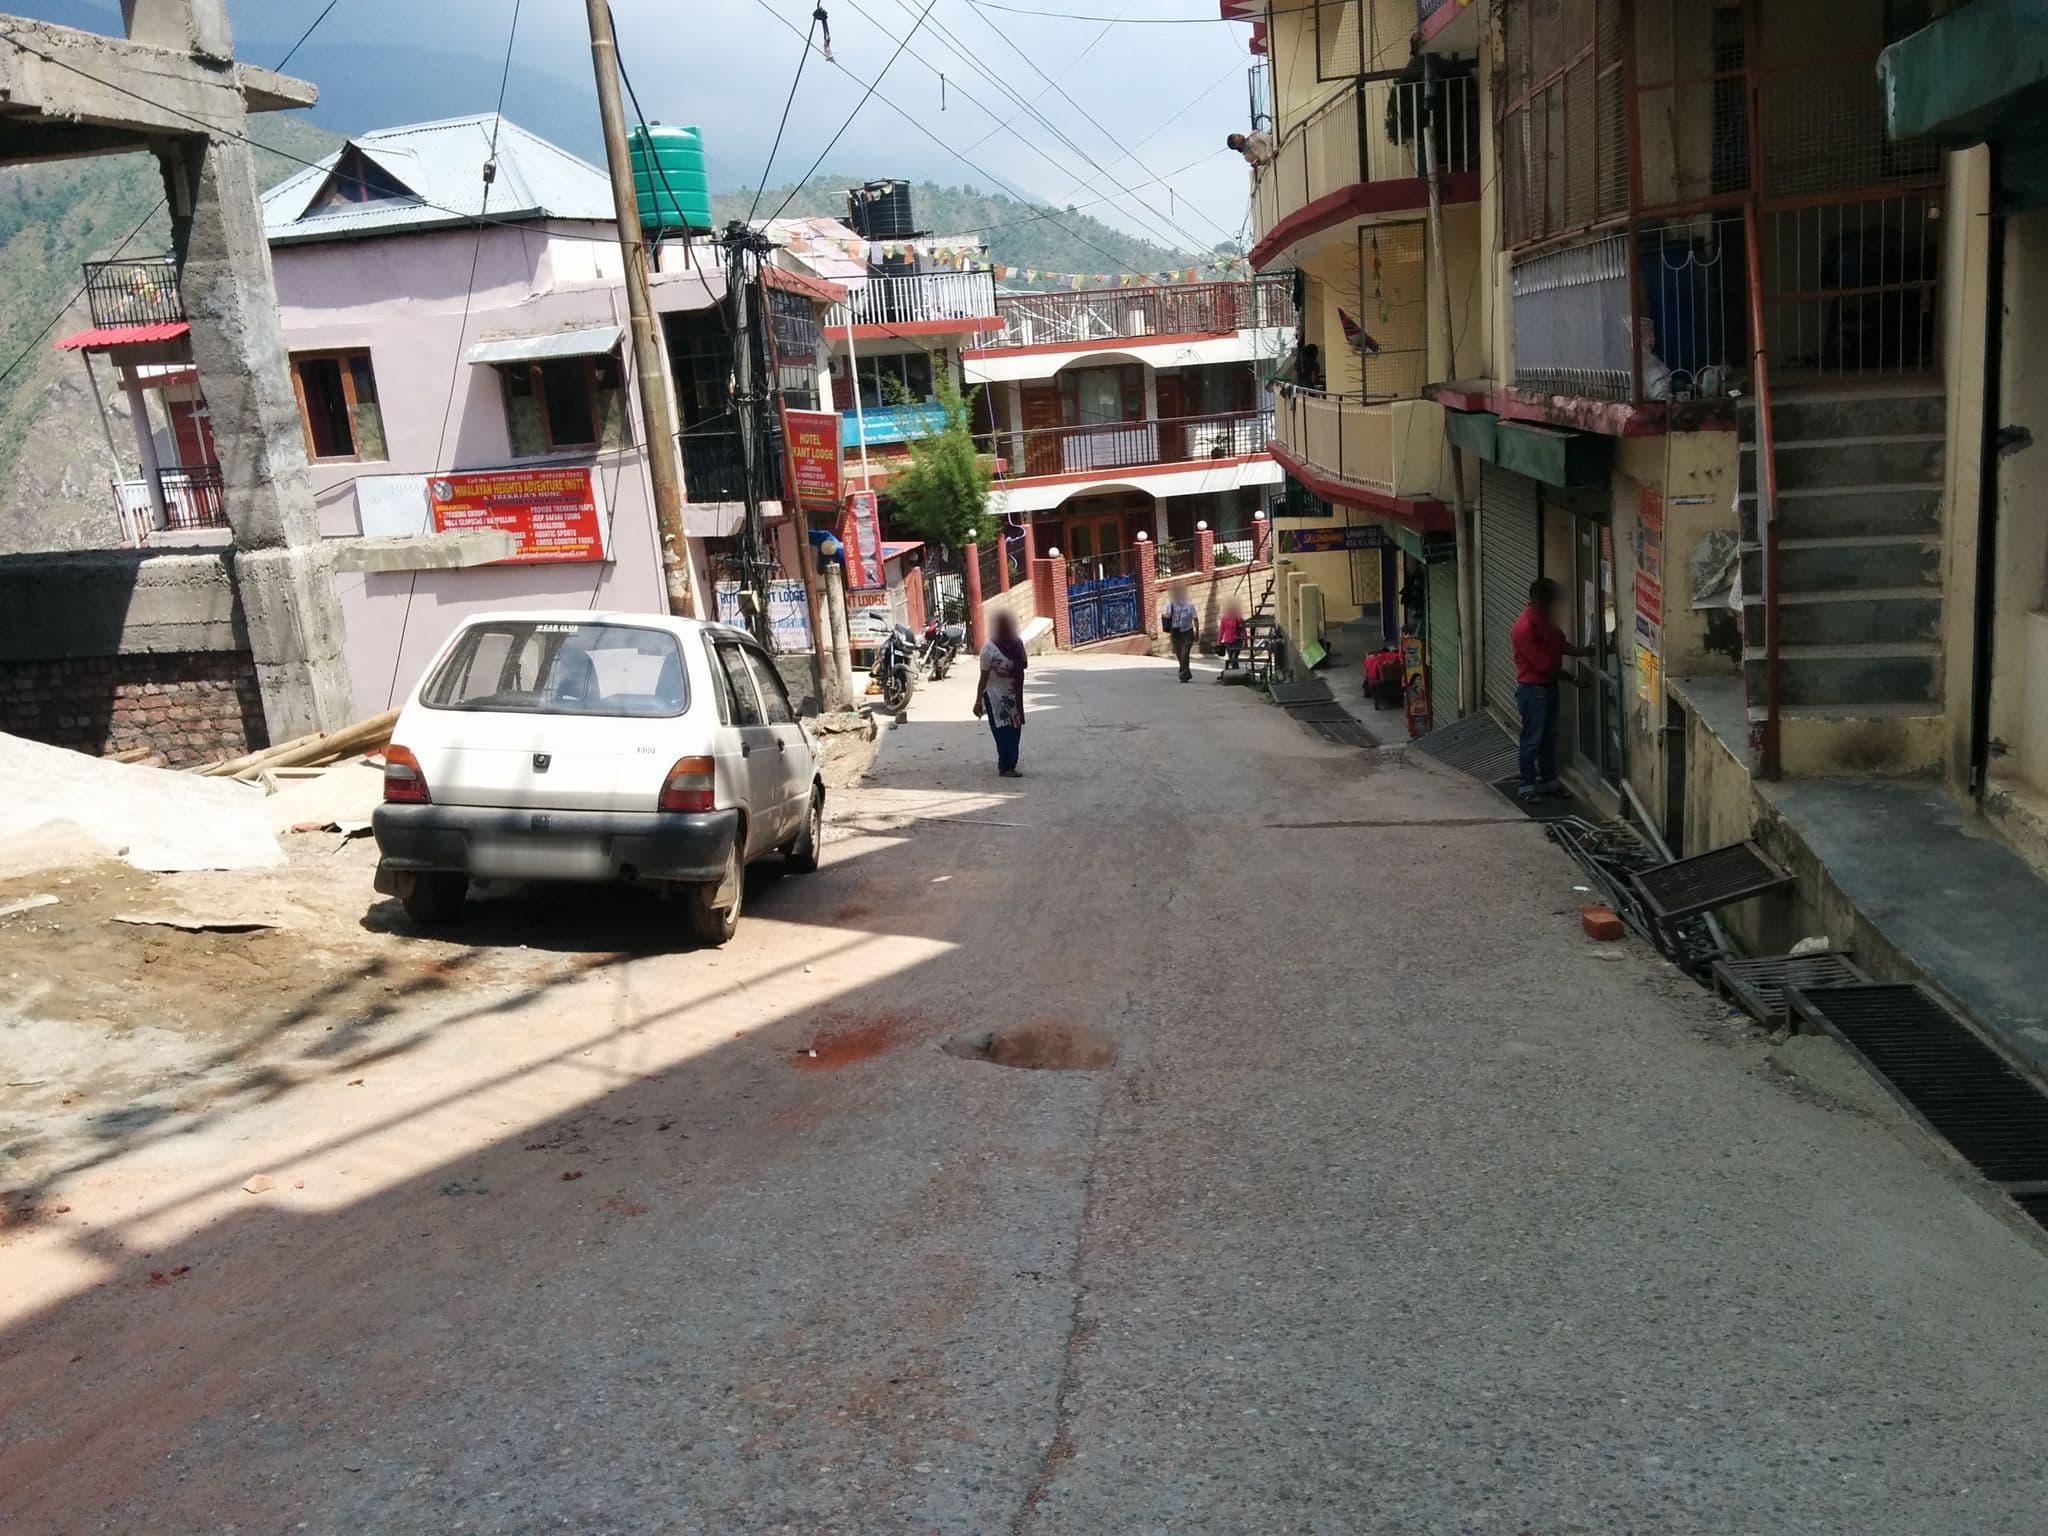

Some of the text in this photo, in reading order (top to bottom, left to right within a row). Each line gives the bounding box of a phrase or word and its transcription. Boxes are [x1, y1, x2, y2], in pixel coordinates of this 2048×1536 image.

[799, 433, 821, 445] HOTEL
[812, 448, 834, 460] LODGE
[493, 481, 523, 494] HEIGHTS
[524, 478, 564, 493] ADVENTURE
[779, 590, 805, 602] LODGE
[858, 594, 887, 607] LODGE
